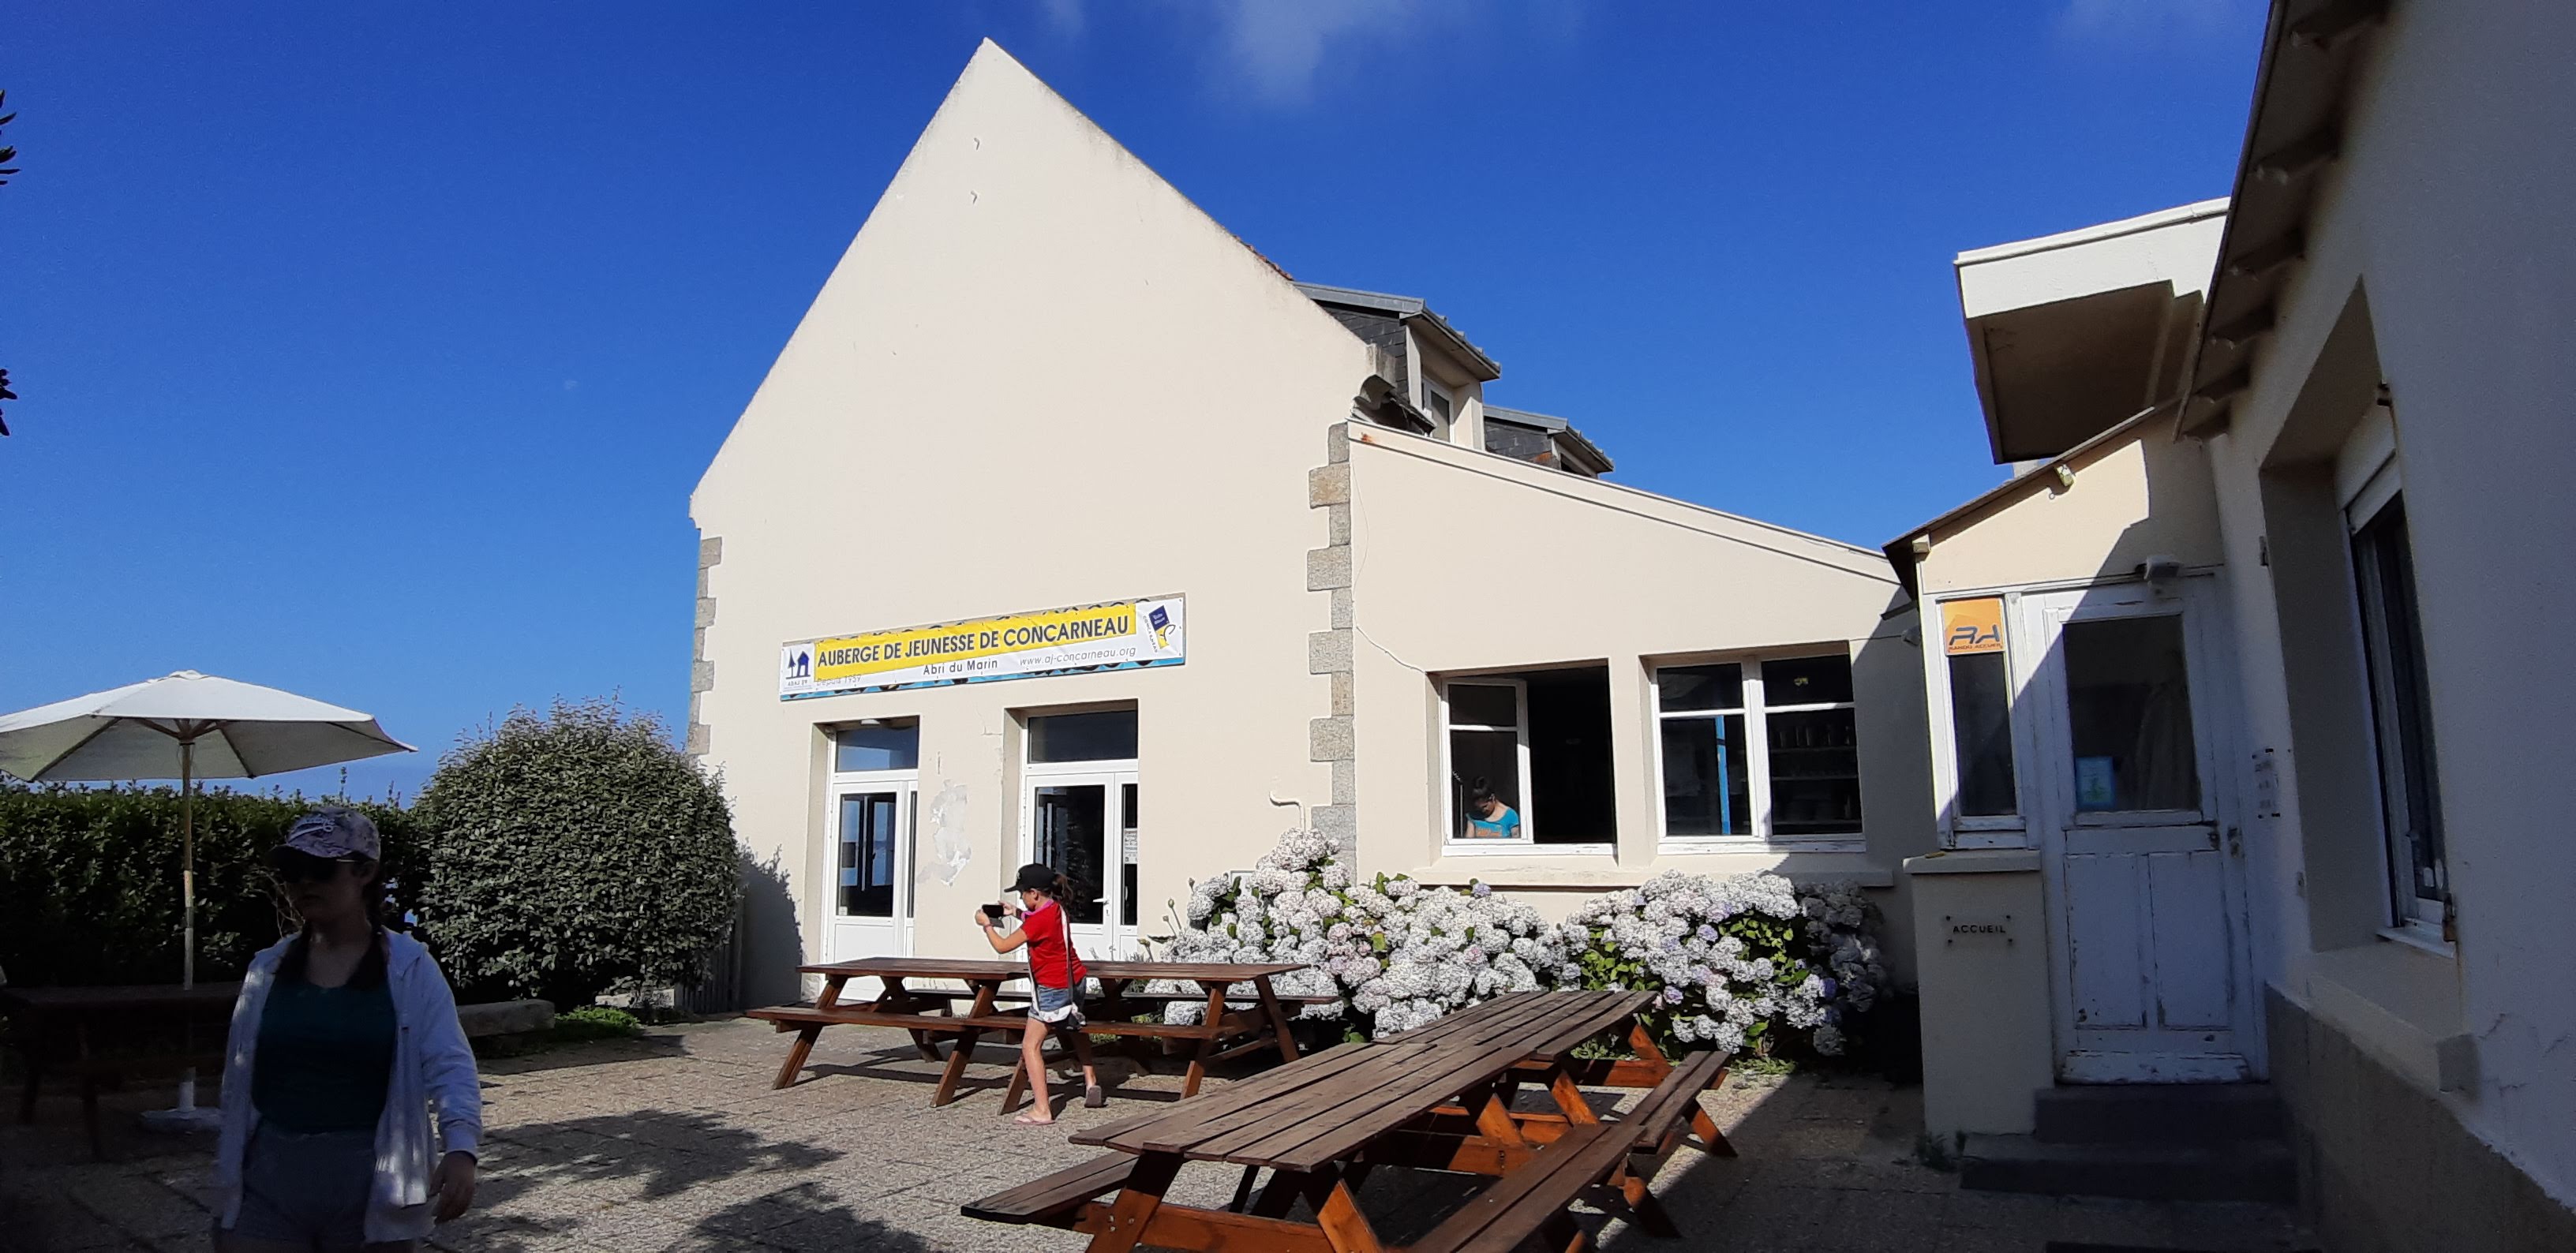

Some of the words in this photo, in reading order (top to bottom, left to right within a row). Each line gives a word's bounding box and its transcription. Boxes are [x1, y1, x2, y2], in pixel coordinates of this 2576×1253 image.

[818, 645, 880, 668] AUBERGE
[884, 641, 902, 660] DE
[905, 633, 975, 657] JEUNESSE
[980, 630, 999, 649] DE
[1004, 615, 1129, 646] CONCARNEAU
[1020, 646, 1136, 666] www.aj-concarneau.org
[923, 662, 945, 675] Abri
[949, 661, 963, 673] du
[967, 658, 998, 671] Marin
[1953, 925, 2005, 933] ACCUEIL
